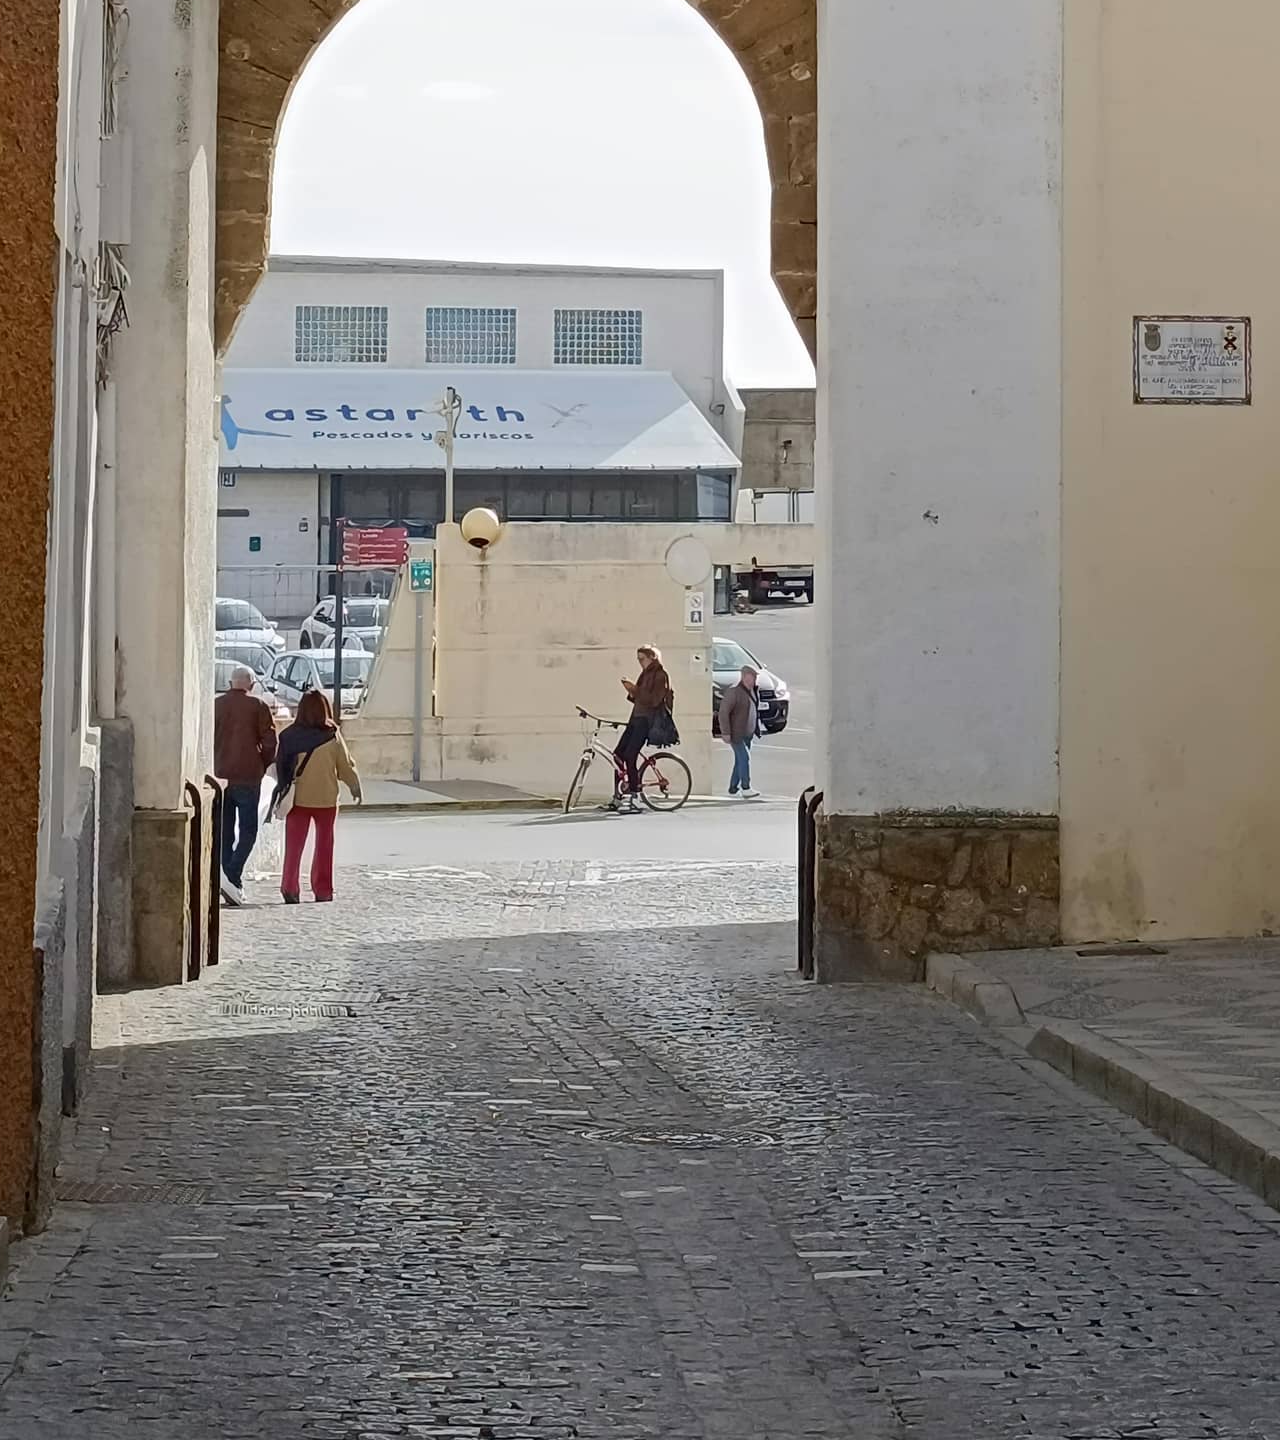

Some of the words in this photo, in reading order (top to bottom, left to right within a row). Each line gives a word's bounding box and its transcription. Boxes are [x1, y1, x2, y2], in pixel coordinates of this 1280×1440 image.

[264, 403, 526, 423] astarth
[312, 430, 414, 440] Pescados
[421, 431, 433, 442] y
[452, 430, 536, 441] ariscos
